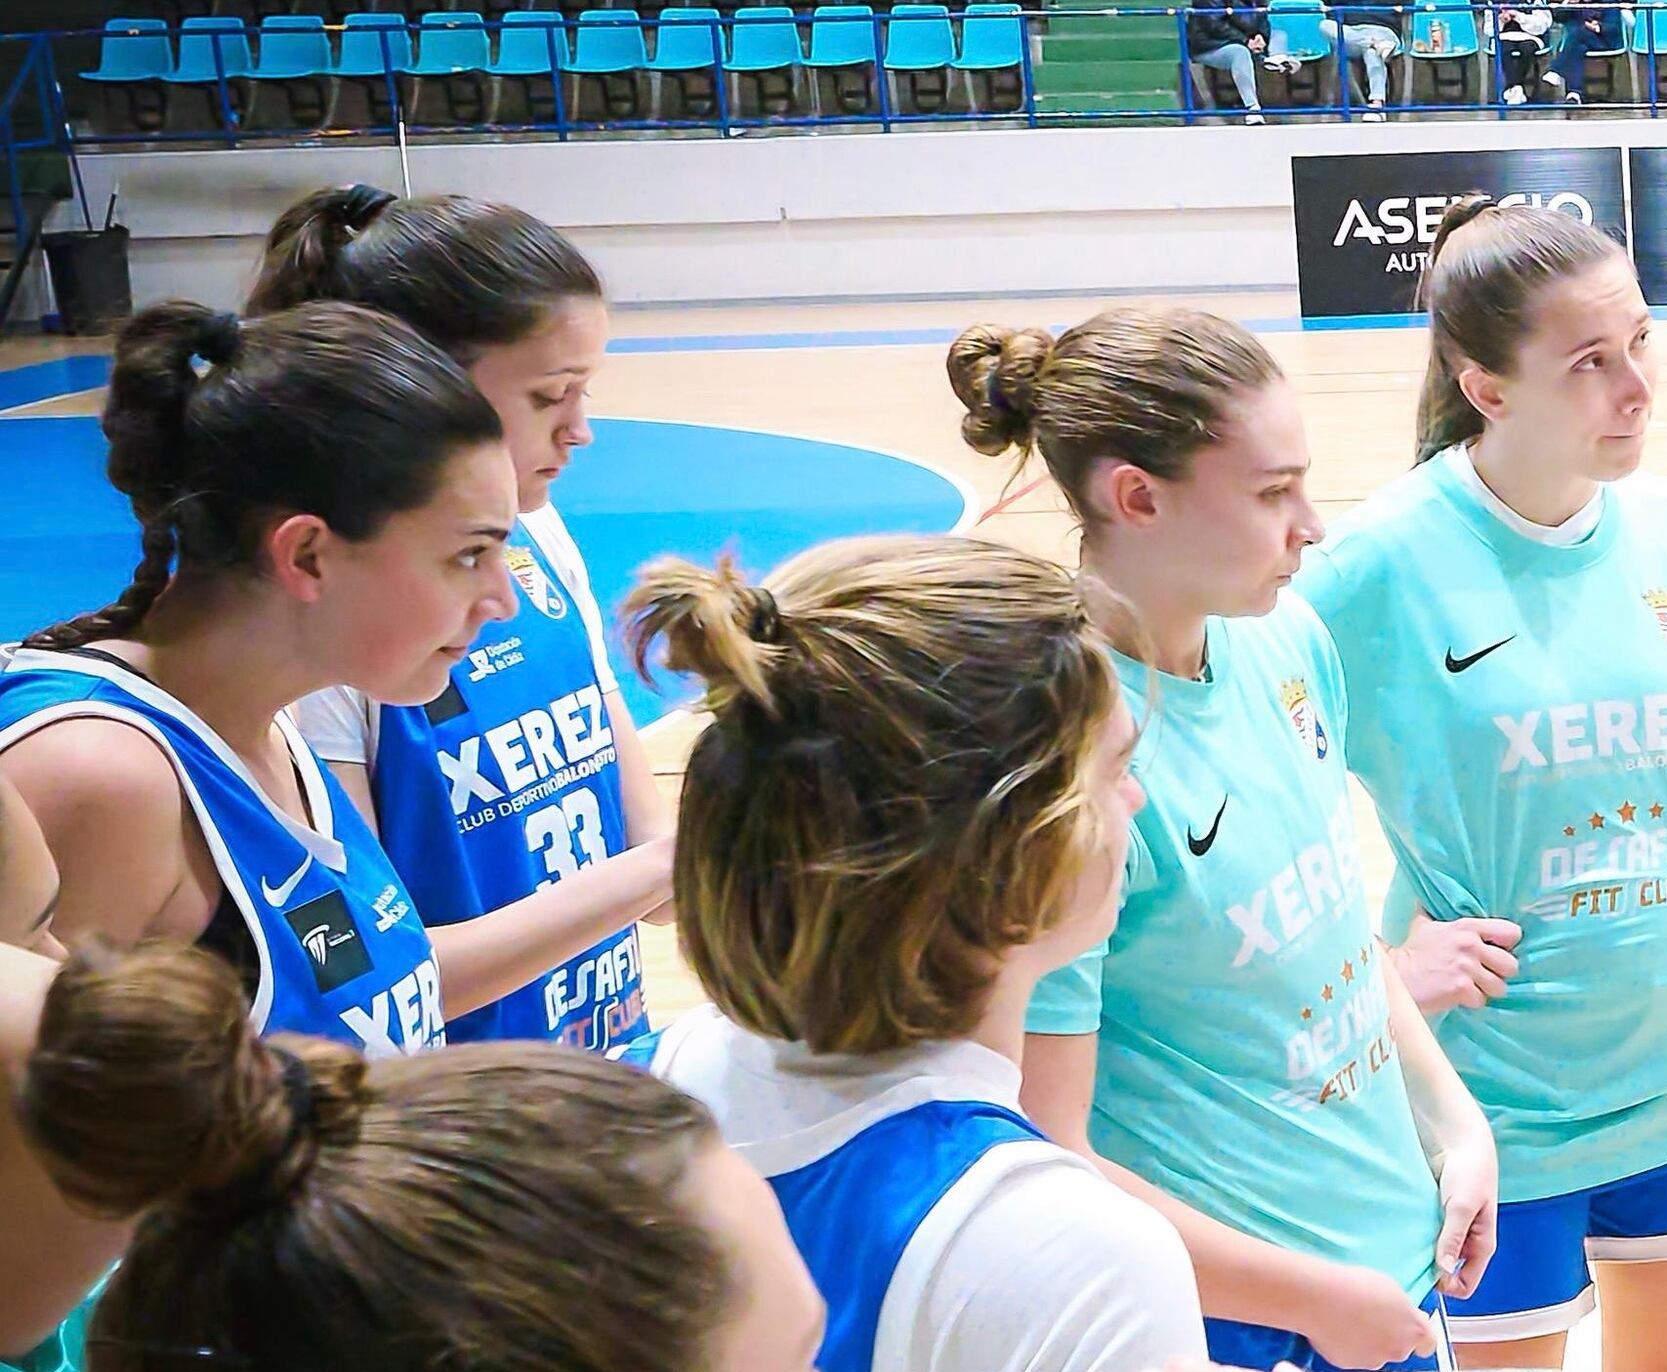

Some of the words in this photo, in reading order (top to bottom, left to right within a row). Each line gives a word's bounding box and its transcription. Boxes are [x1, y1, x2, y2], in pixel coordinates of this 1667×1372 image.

[437, 683, 614, 816] XEREZ
[523, 786, 610, 889] 33
[1570, 886, 1623, 918] FIT
